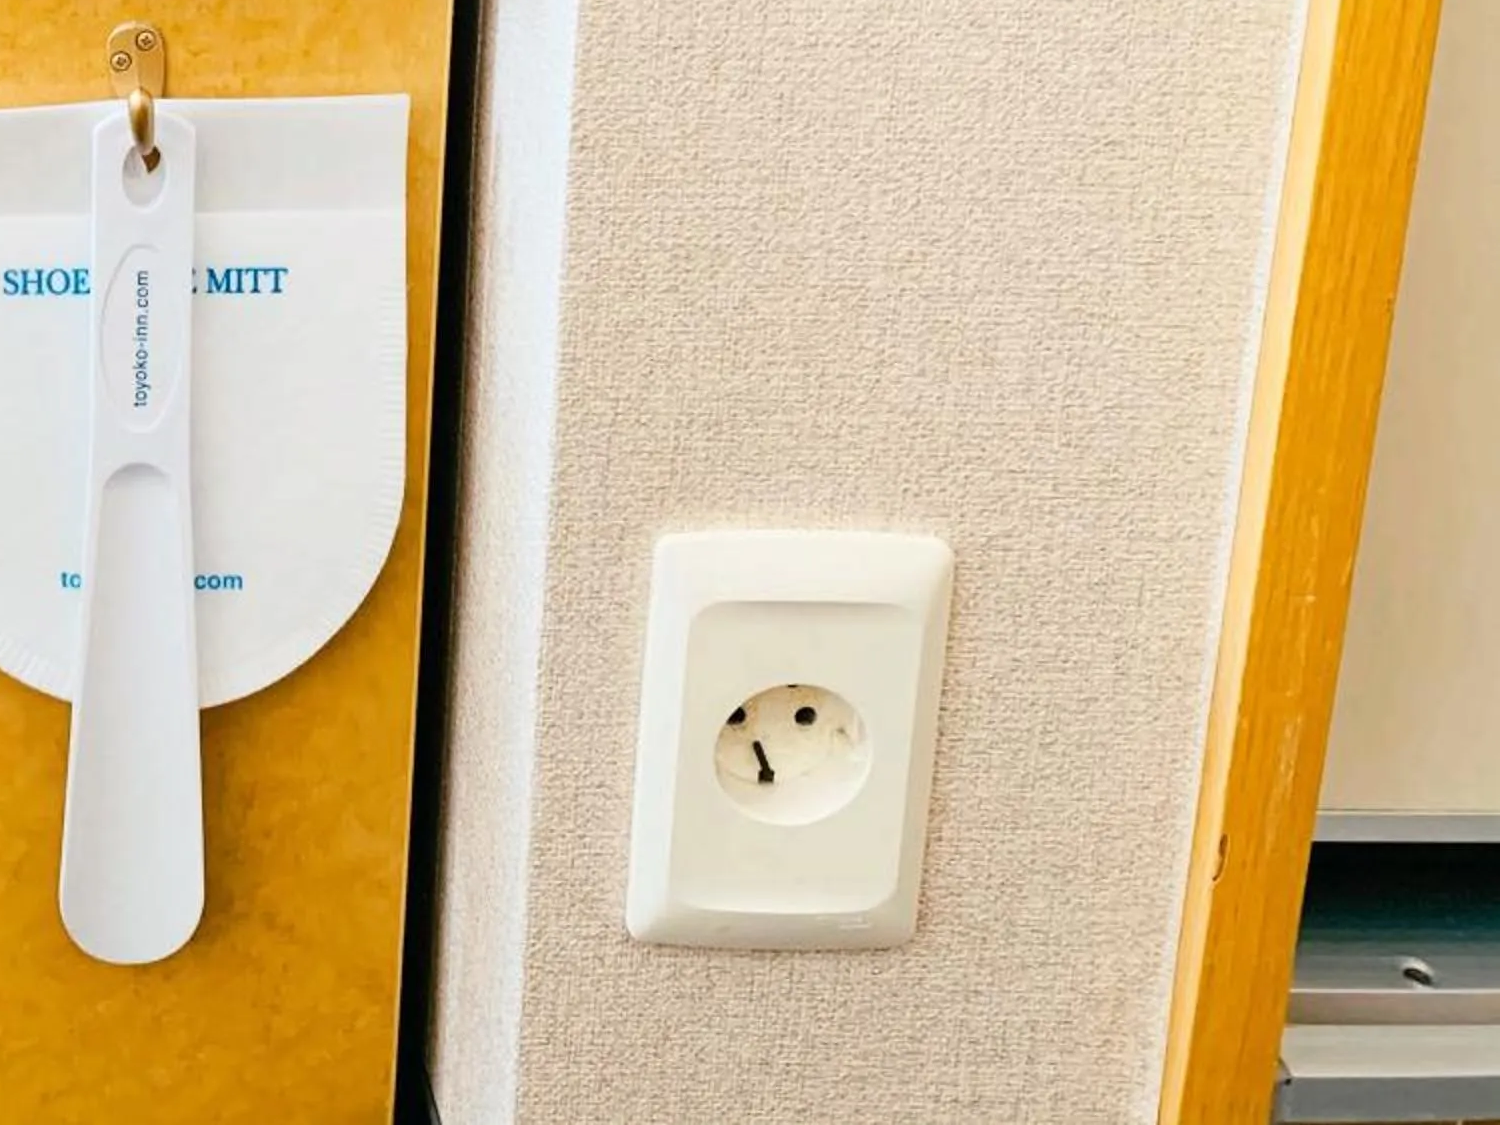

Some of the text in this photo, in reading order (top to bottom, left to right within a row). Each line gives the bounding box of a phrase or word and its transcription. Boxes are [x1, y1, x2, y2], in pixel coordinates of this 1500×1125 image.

[3, 268, 91, 296] SHOE
[205, 267, 289, 295] MITT
[132, 269, 152, 408] toyoko-inn.com
